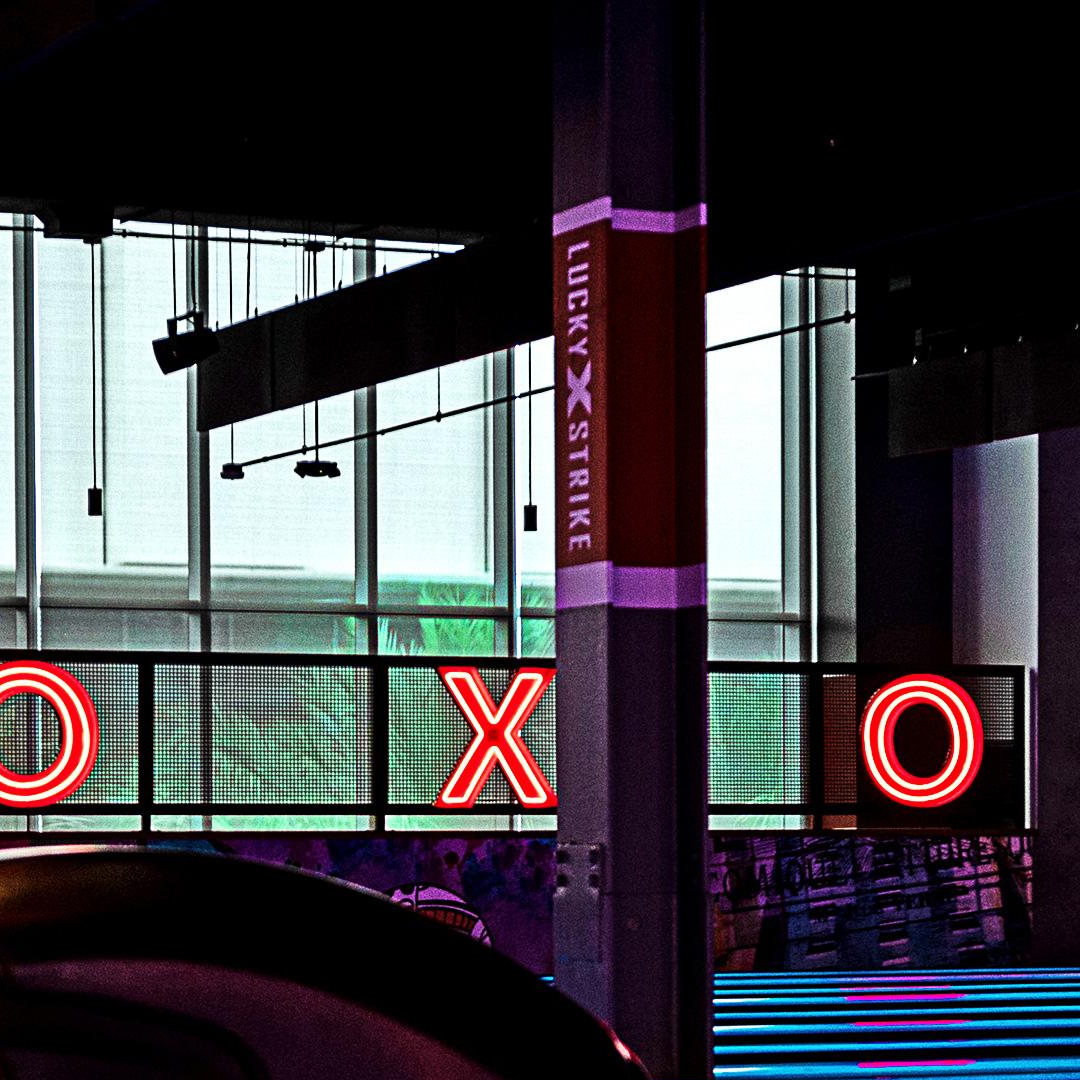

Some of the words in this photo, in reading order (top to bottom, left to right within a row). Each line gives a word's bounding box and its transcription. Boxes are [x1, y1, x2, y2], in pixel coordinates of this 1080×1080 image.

[566, 240, 591, 357] LUCKY
[567, 420, 592, 551] STRIKE
[433, 666, 559, 809] X
[860, 673, 985, 809] O
